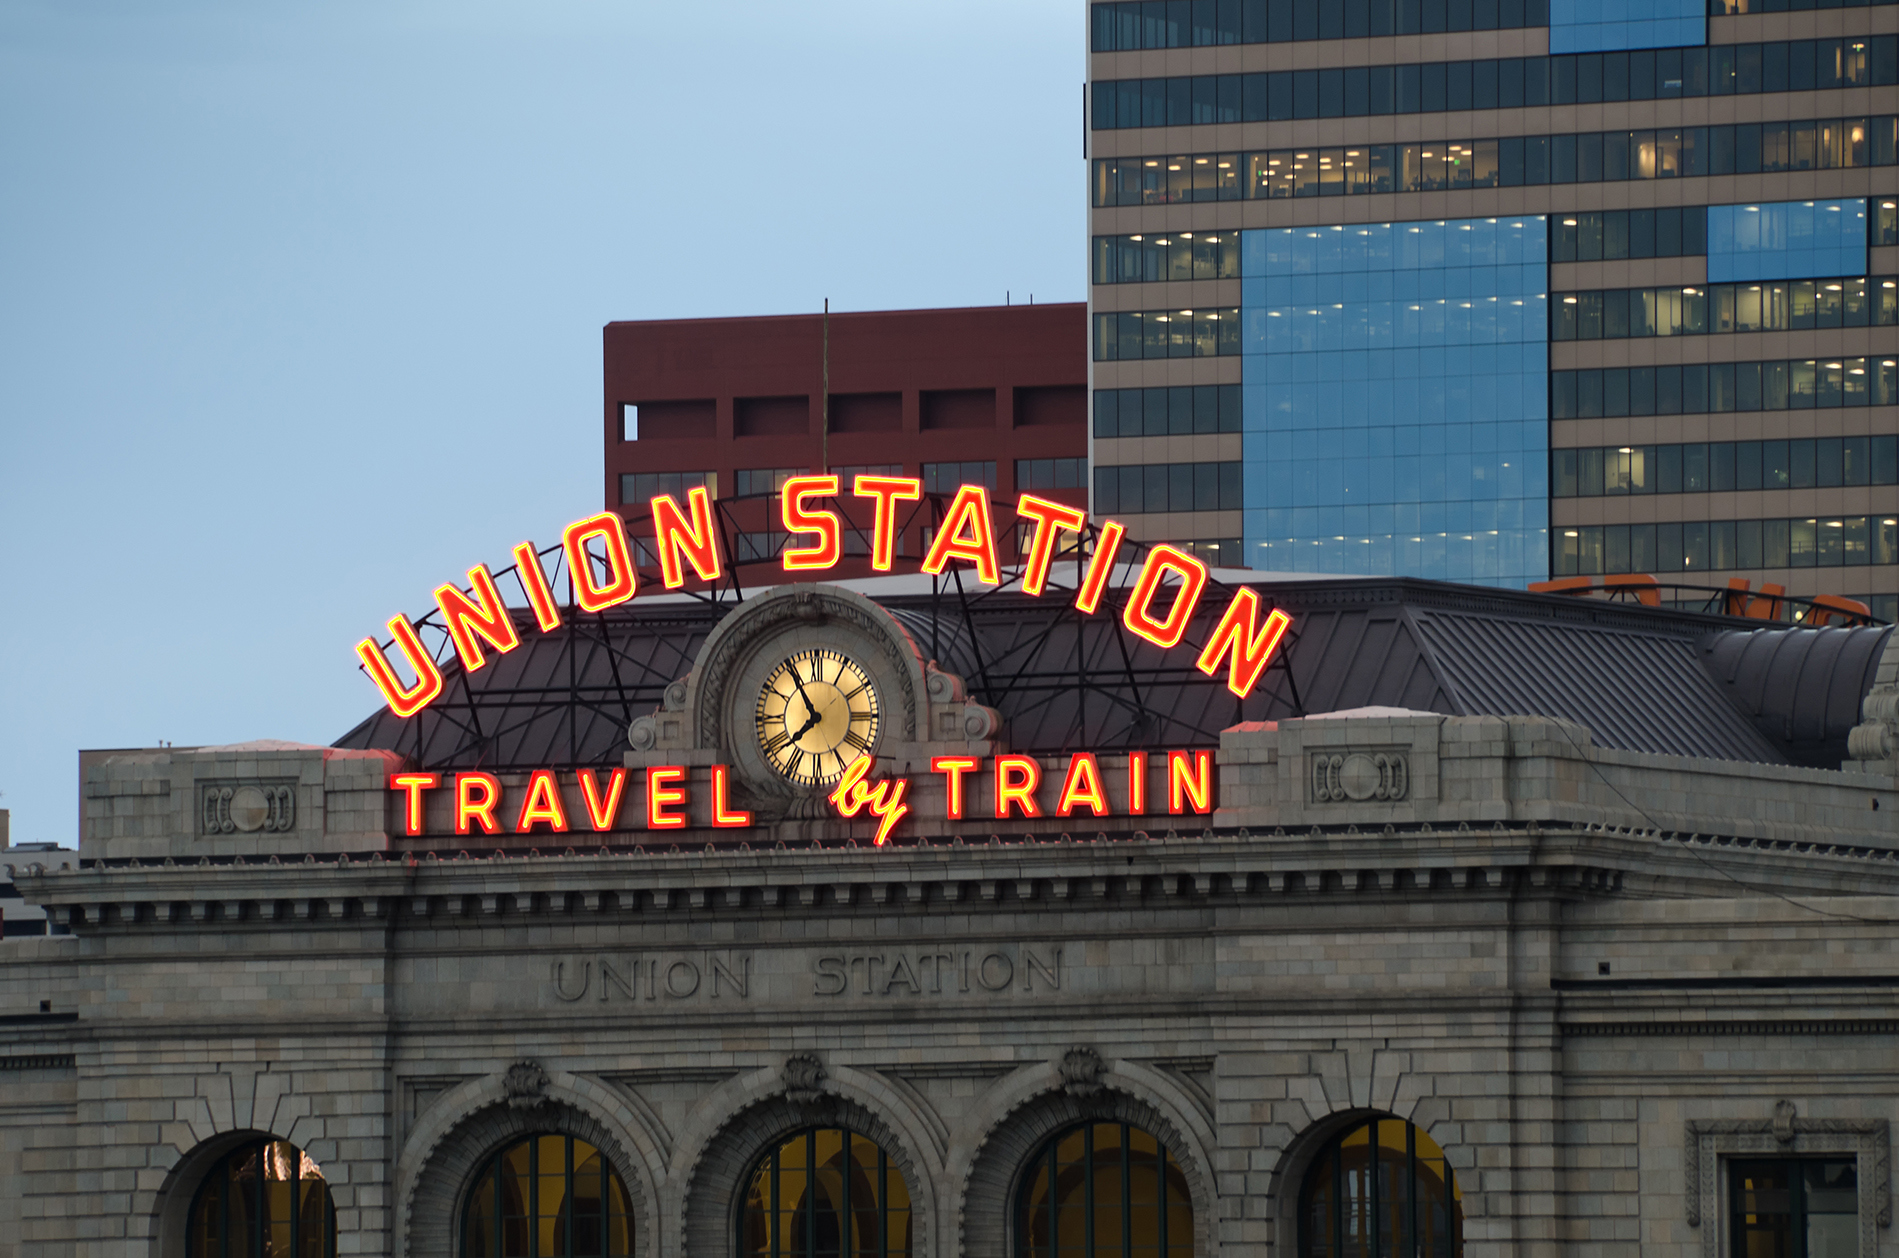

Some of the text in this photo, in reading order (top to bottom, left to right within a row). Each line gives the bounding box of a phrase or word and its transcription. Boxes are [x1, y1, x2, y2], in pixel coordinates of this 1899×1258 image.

[355, 473, 1294, 719] UNION STATION
[810, 658, 823, 682] XII
[390, 750, 1216, 848] TRAVEL by TRAIN
[553, 949, 1063, 1002] UNION STATION
